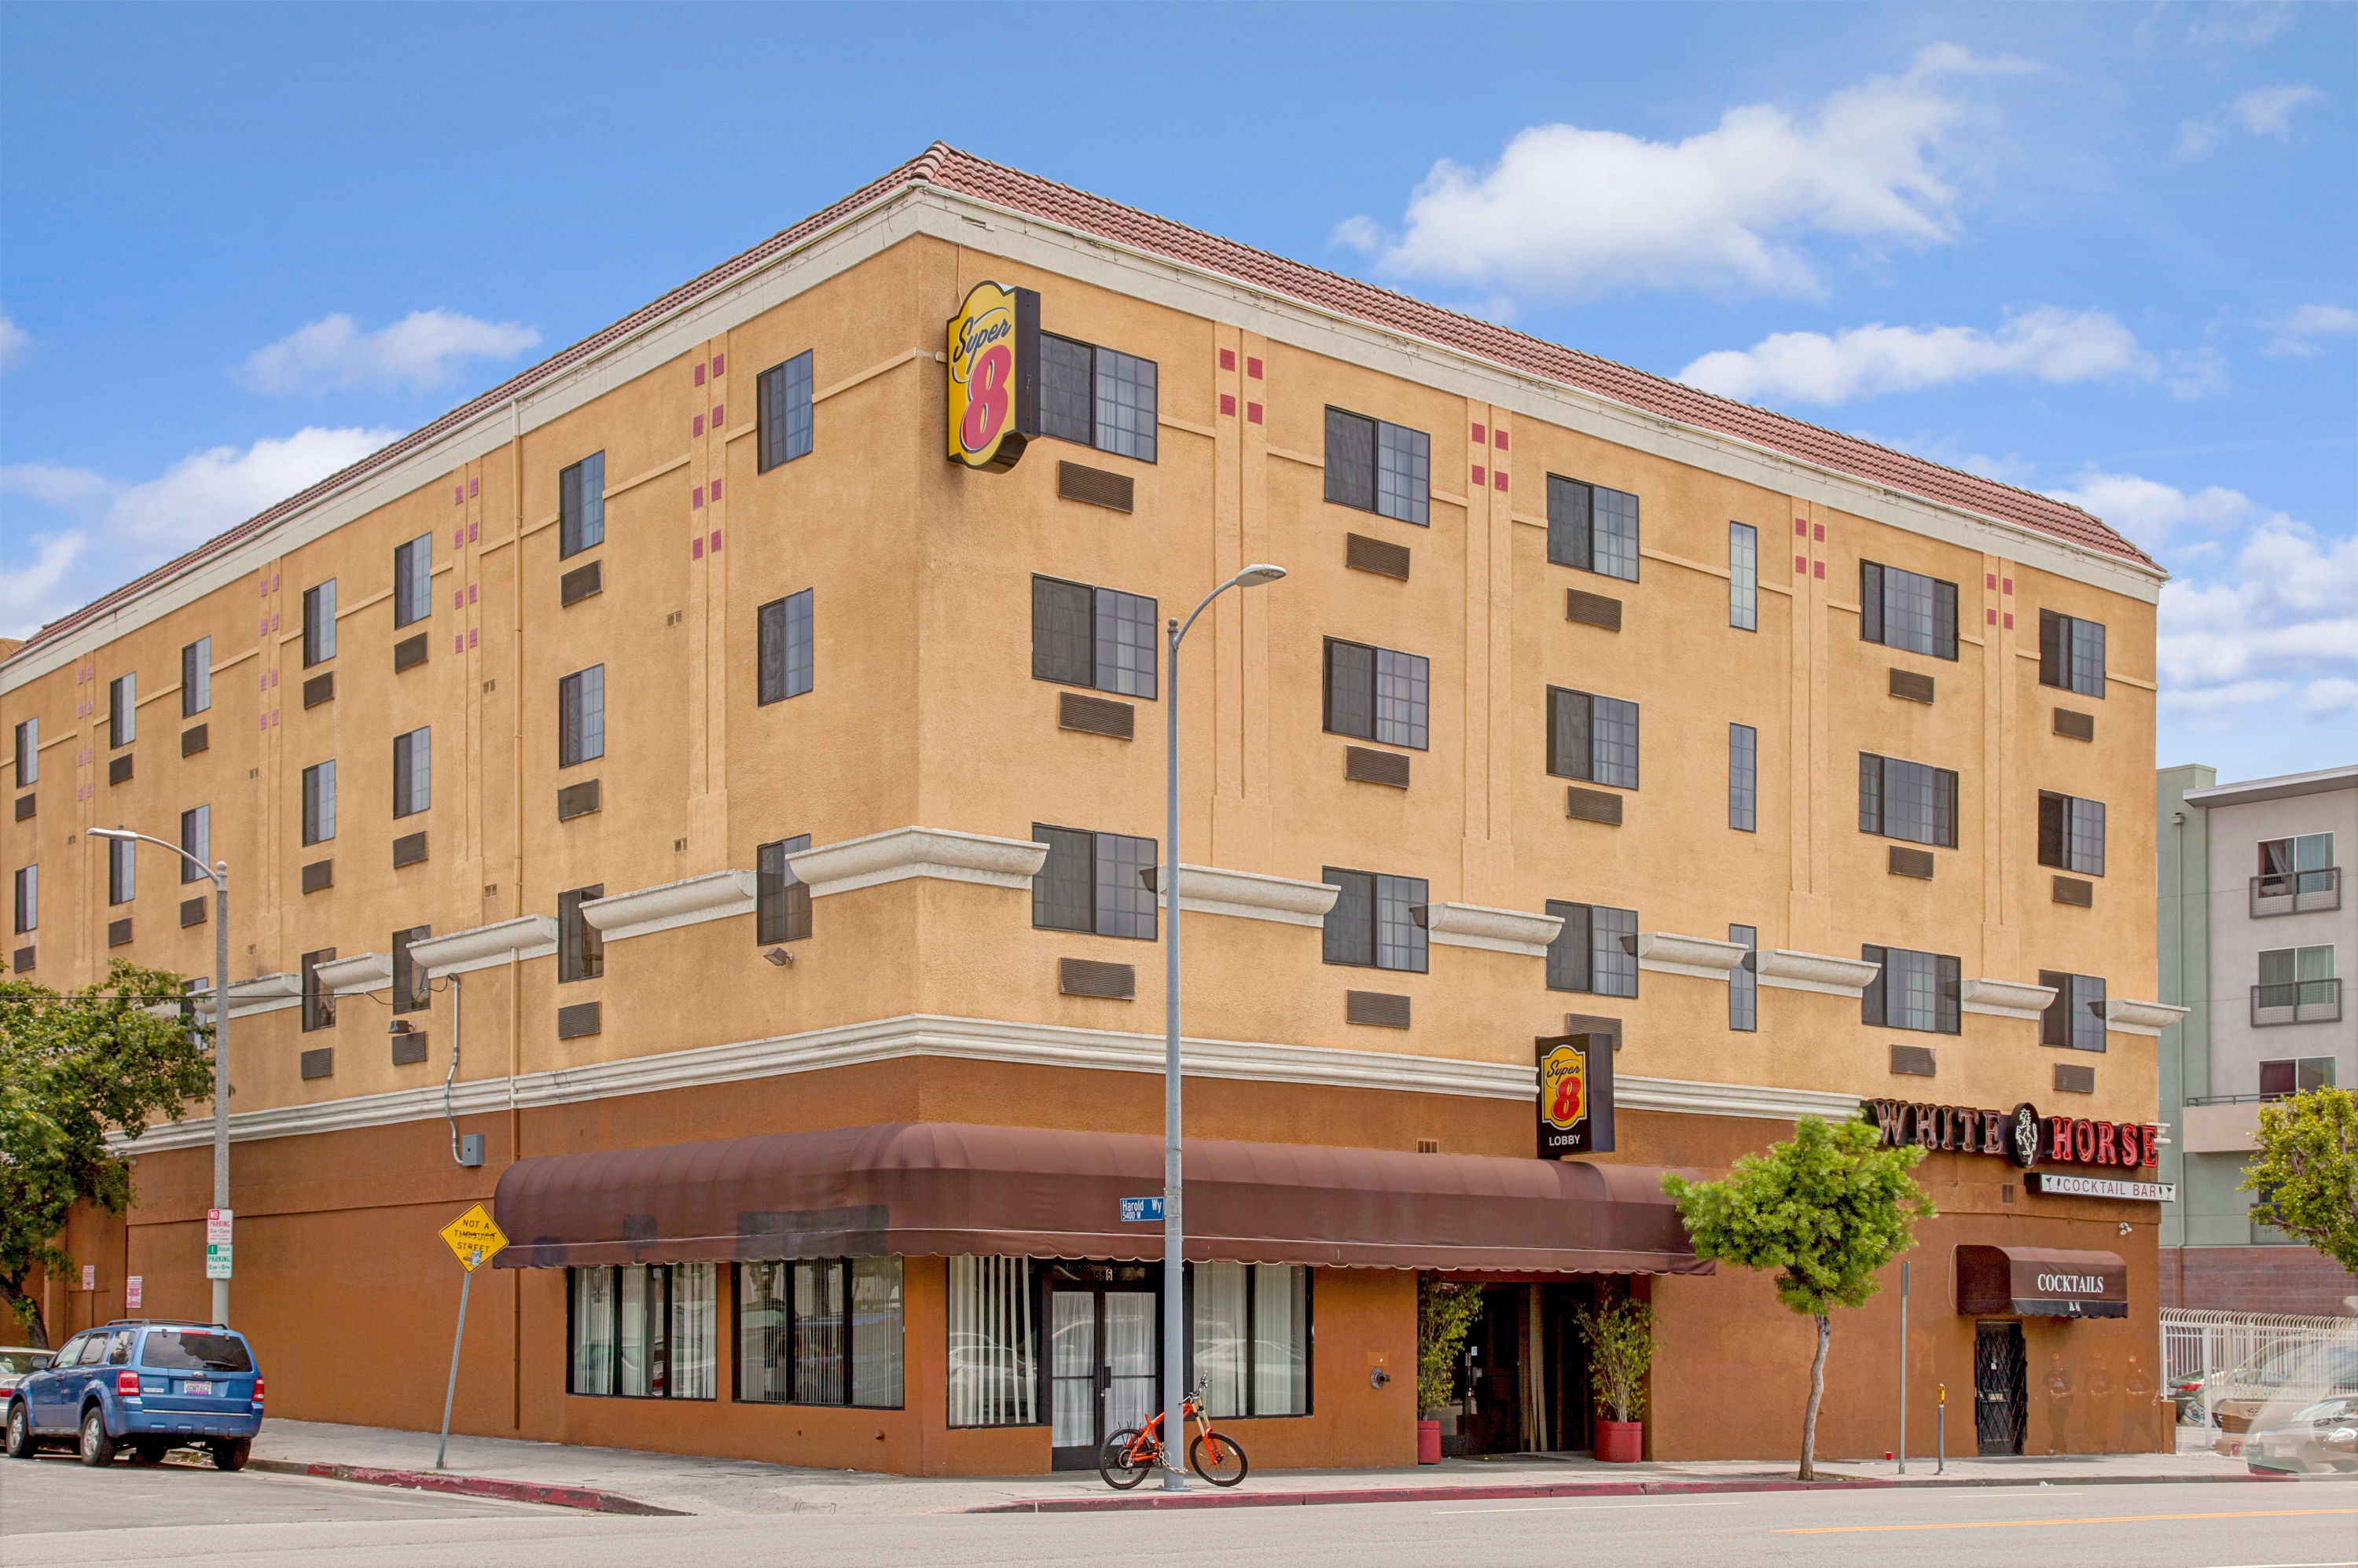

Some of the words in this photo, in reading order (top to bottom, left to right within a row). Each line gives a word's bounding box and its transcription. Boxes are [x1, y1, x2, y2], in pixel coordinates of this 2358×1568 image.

[953, 316, 1012, 376] Super
[960, 344, 1012, 454] 8
[1546, 1059, 1581, 1085] Super
[1552, 1076, 1581, 1121] 8
[1548, 1134, 1581, 1146] LOBBY
[1873, 1099, 2003, 1154] WHITE
[2051, 1116, 2158, 1168] HORSE
[2063, 1178, 2125, 1195] COCKTAIL
[2132, 1184, 2156, 1198] BAR
[1122, 1199, 1144, 1211] Harold
[1151, 1199, 1162, 1214] Wy
[1122, 1211, 1135, 1220] 5400
[463, 1219, 480, 1228] NOT
[457, 1241, 490, 1253] STREET
[2037, 1273, 2103, 1293] COCKTAILS
